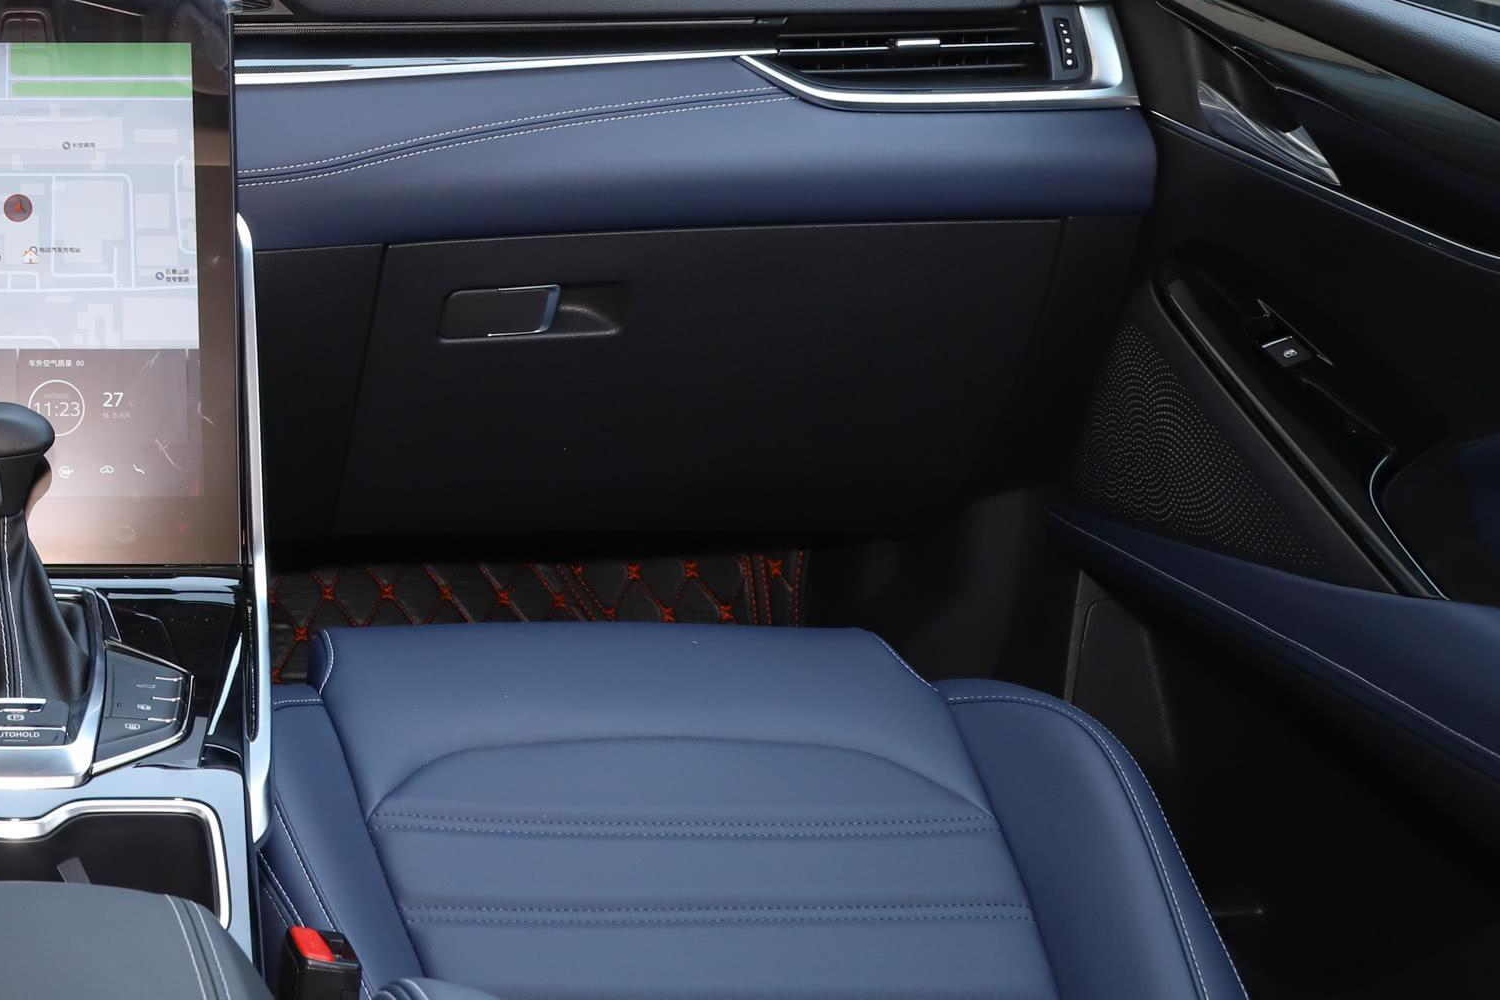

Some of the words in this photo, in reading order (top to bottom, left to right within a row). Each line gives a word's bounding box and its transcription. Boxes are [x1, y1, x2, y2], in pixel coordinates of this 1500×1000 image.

[28, 359, 73, 367] 车外空气质量
[102, 392, 124, 408] 27
[33, 402, 81, 417] 11:23
